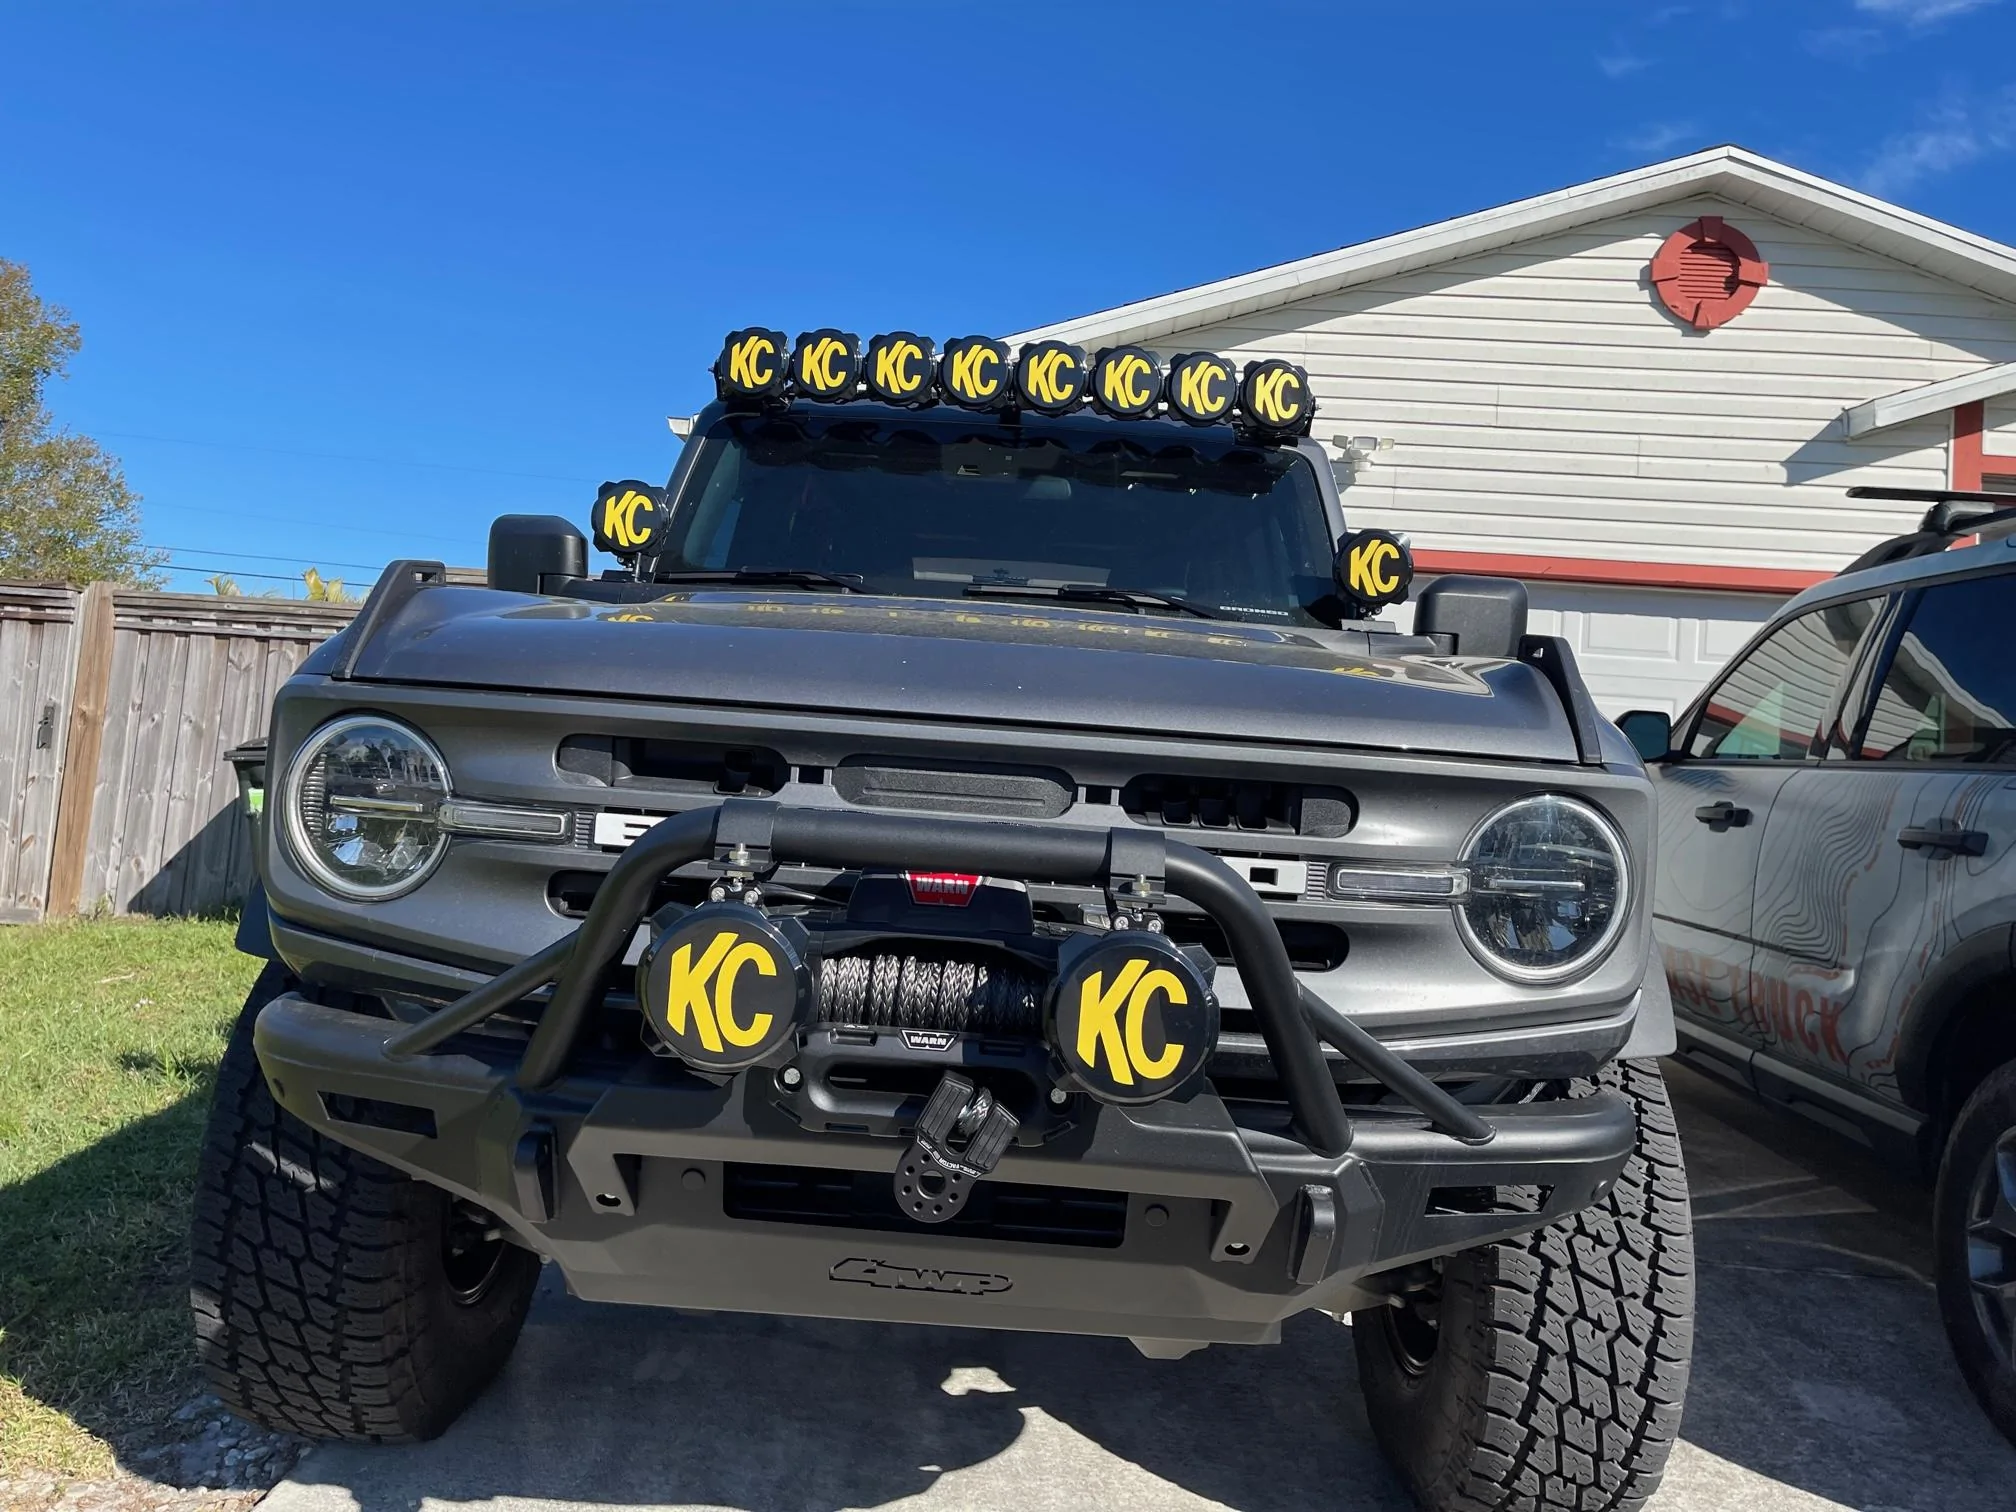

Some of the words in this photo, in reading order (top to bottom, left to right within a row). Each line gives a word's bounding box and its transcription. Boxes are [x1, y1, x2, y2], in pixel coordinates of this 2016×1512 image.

[730, 336, 774, 388] KC
[802, 338, 848, 390] KC
[876, 341, 922, 394] KC
[952, 345, 999, 398] KC
[1028, 350, 1075, 403] KC
[1104, 355, 1151, 408] KC
[1181, 361, 1227, 414] KC
[1255, 368, 1299, 421] KC
[603, 491, 654, 546] KC
[1350, 541, 1399, 597] KC
[916, 877, 970, 895] WARN
[667, 932, 777, 1053] KC
[910, 1035, 947, 1046] WARN
[1077, 959, 1188, 1085] KC
